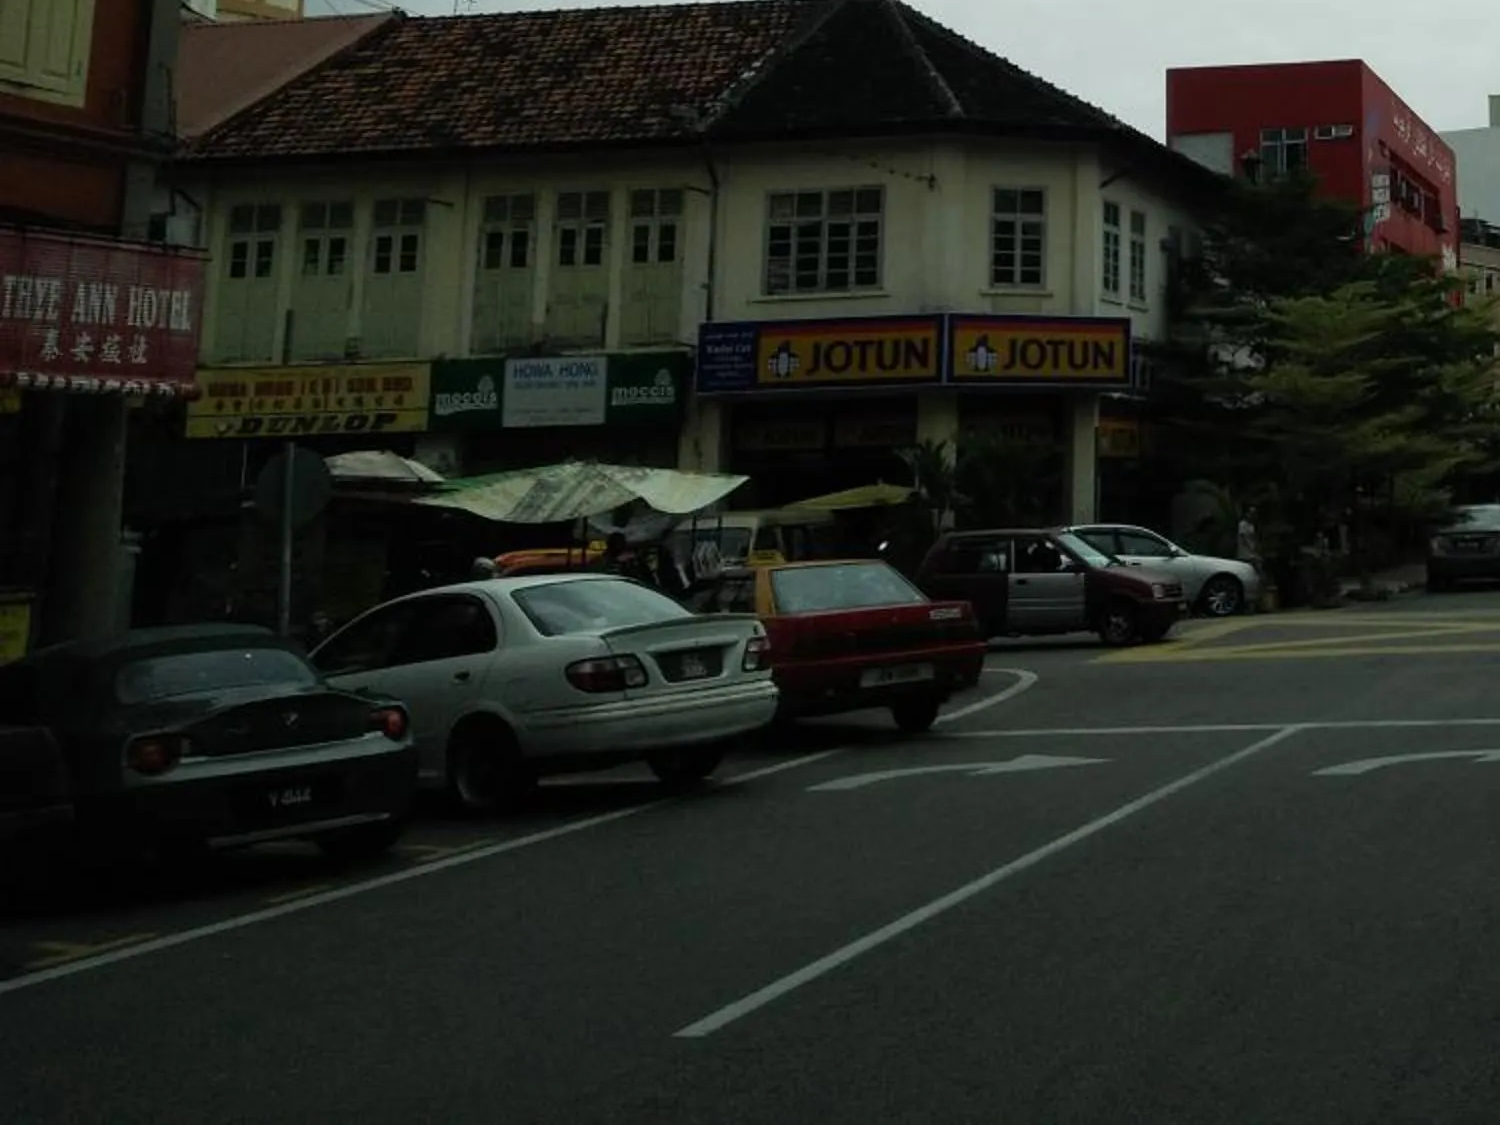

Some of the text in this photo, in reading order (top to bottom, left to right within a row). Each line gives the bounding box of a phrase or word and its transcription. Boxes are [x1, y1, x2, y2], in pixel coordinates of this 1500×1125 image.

[71, 282, 118, 325] ANN
[127, 285, 192, 331] HOTEL
[804, 336, 932, 375] JOTUN
[1002, 338, 1115, 371] JOTUN
[236, 412, 399, 435] DUNLOP
